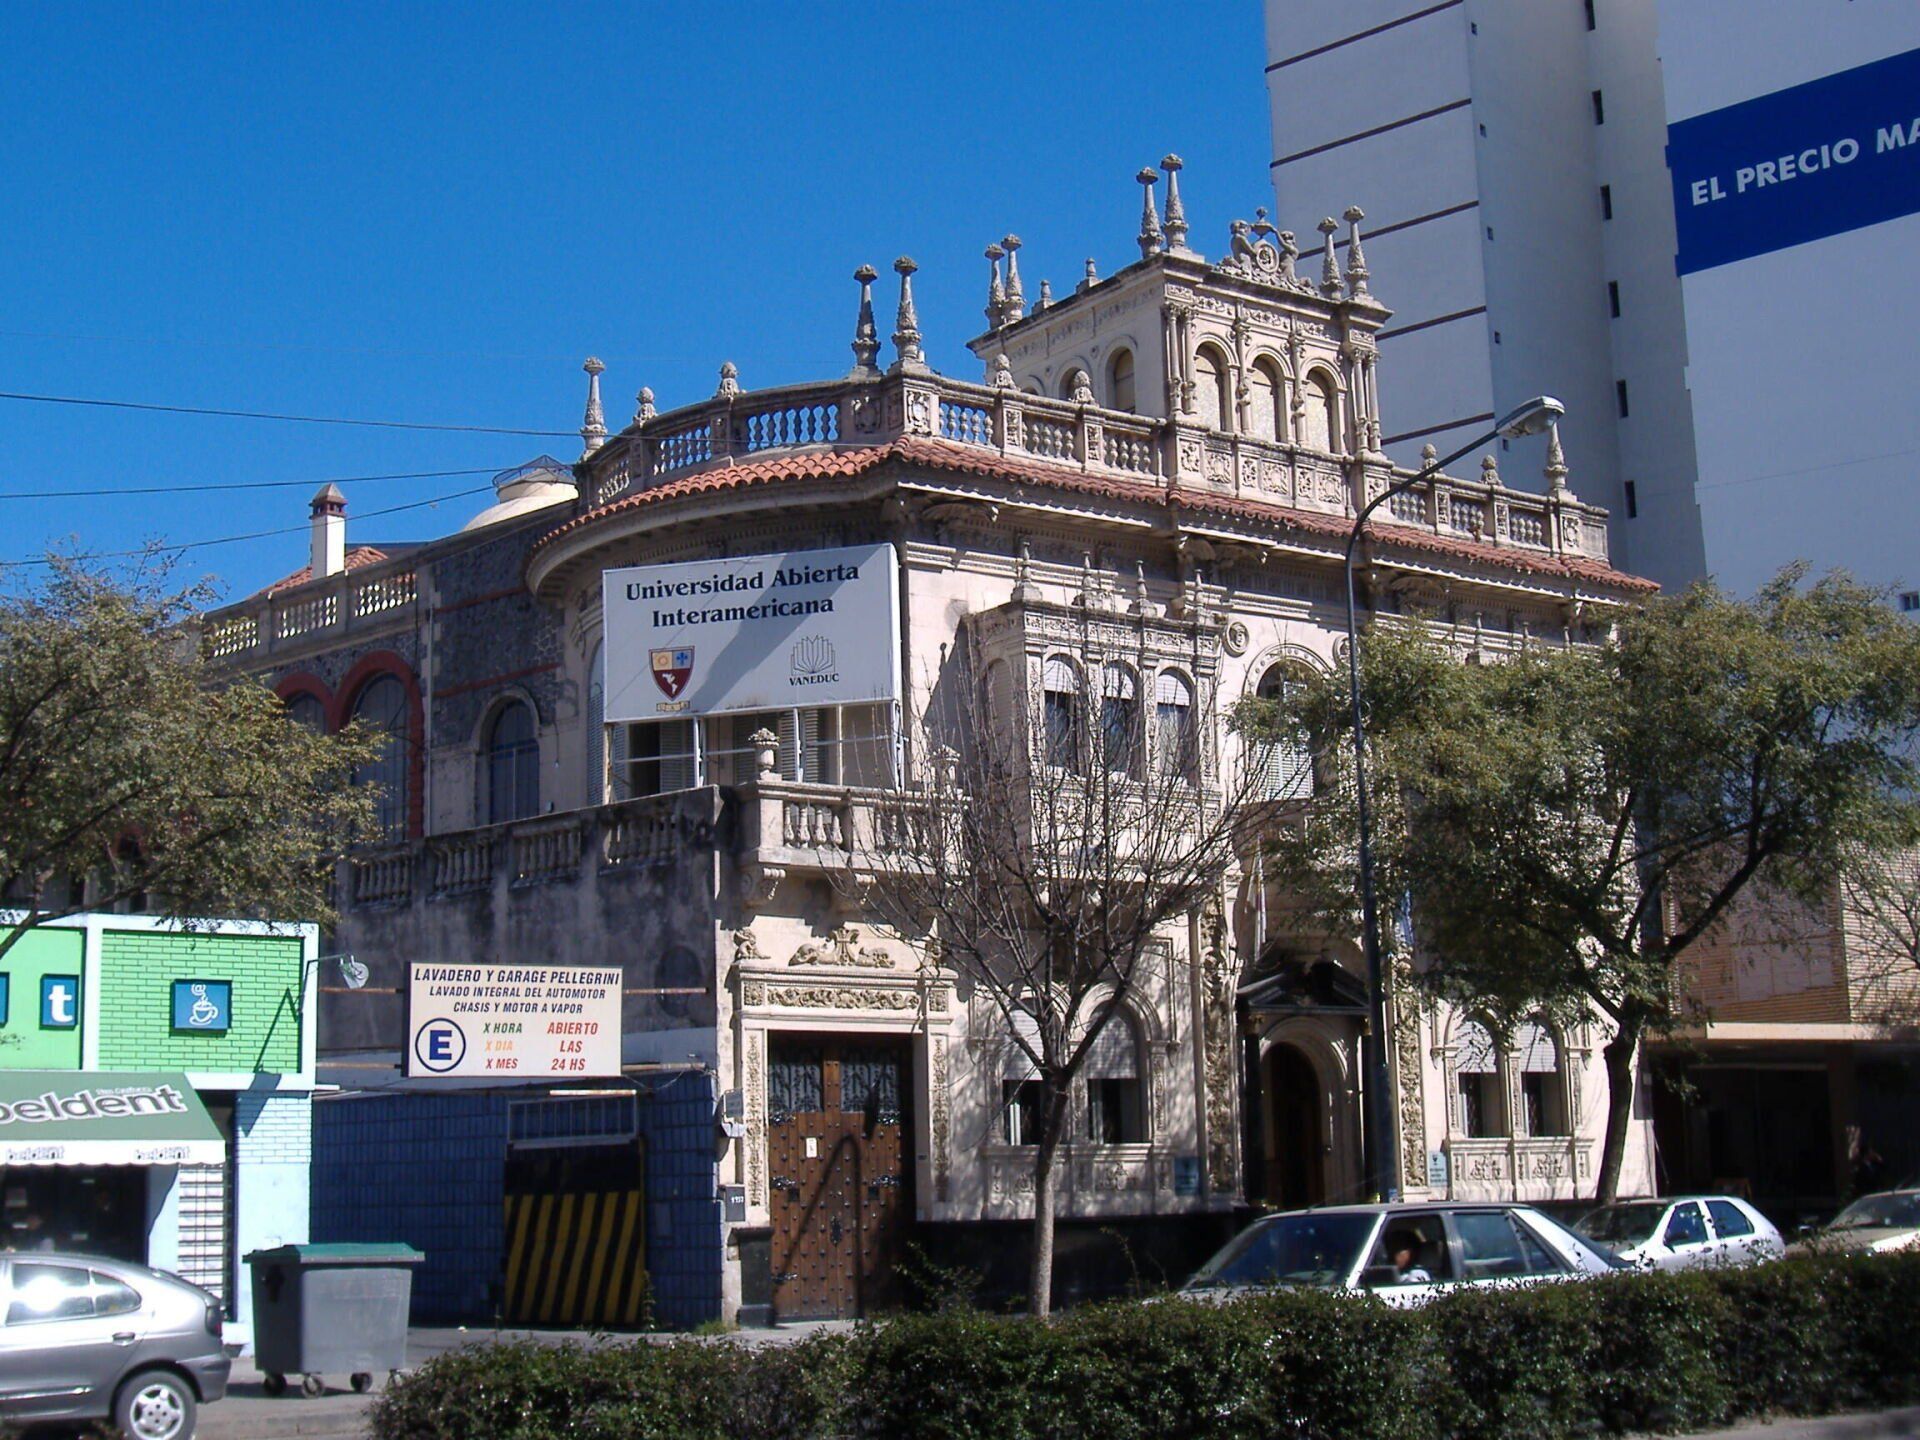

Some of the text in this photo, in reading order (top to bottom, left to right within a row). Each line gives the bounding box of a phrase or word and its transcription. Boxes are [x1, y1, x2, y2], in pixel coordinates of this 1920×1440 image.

[1691, 176, 1727, 206] EL
[1736, 138, 1860, 193] PRECIO
[626, 564, 860, 601] Universidad Abierta
[652, 598, 834, 628] Interamericana
[789, 674, 840, 687] VANEDUC
[414, 968, 620, 985] LAVADERO Y GARAGE PELLEGRINI
[429, 985, 606, 999] LAVADO INTEGRAL DEL AUTOMOTOR
[453, 1001, 583, 1014] CHASIS Y MOTOR A VAPOR
[483, 1022, 523, 1033] X HORA
[547, 1022, 599, 1035] ABIERTO
[429, 1029, 453, 1060] E
[485, 1040, 513, 1051] X DIA
[559, 1040, 583, 1053] LAS
[485, 1058, 518, 1069] X MES
[551, 1058, 586, 1071] 24 HS
